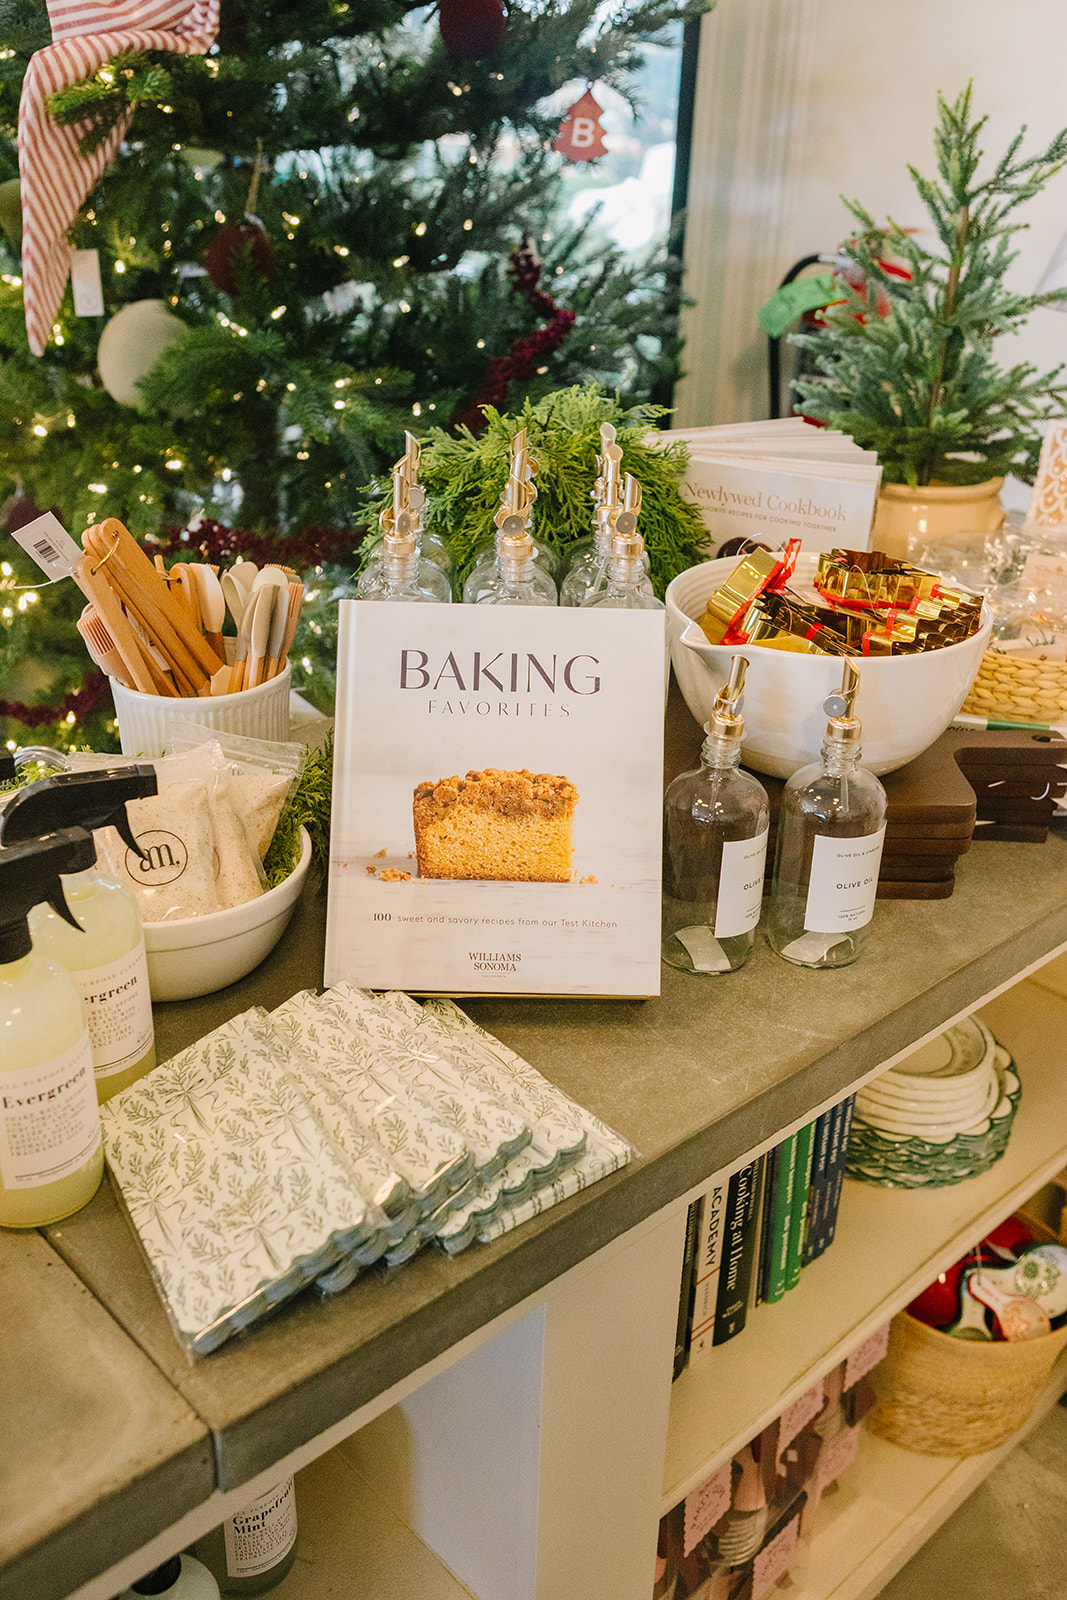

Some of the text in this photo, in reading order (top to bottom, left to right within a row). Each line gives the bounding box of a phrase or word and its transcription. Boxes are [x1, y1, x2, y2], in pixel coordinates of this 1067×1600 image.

[571, 117, 595, 148] B
[684, 481, 847, 521] Newlywed Cookbook
[701, 506, 837, 532] AVORITE RECIPES FOR COOKING TOGETHER
[399, 649, 601, 696] BAKING
[428, 700, 571, 718] FAVORITES
[743, 878, 761, 890] OLIVE
[836, 877, 873, 889] OLIVE OIL
[372, 912, 618, 929] 100 sweet and savory recipes from our Test Kitchen
[468, 952, 522, 962] WILLIAMS
[473, 962, 517, 972] SONOMA
[2, 1066, 86, 1109] Evergreen
[730, 1165, 752, 1230] Cooking
[705, 1186, 723, 1267] ACADEMY
[731, 1231, 743, 1247] at
[726, 1246, 743, 1291] Home
[234, 1521, 266, 1534] Mint
